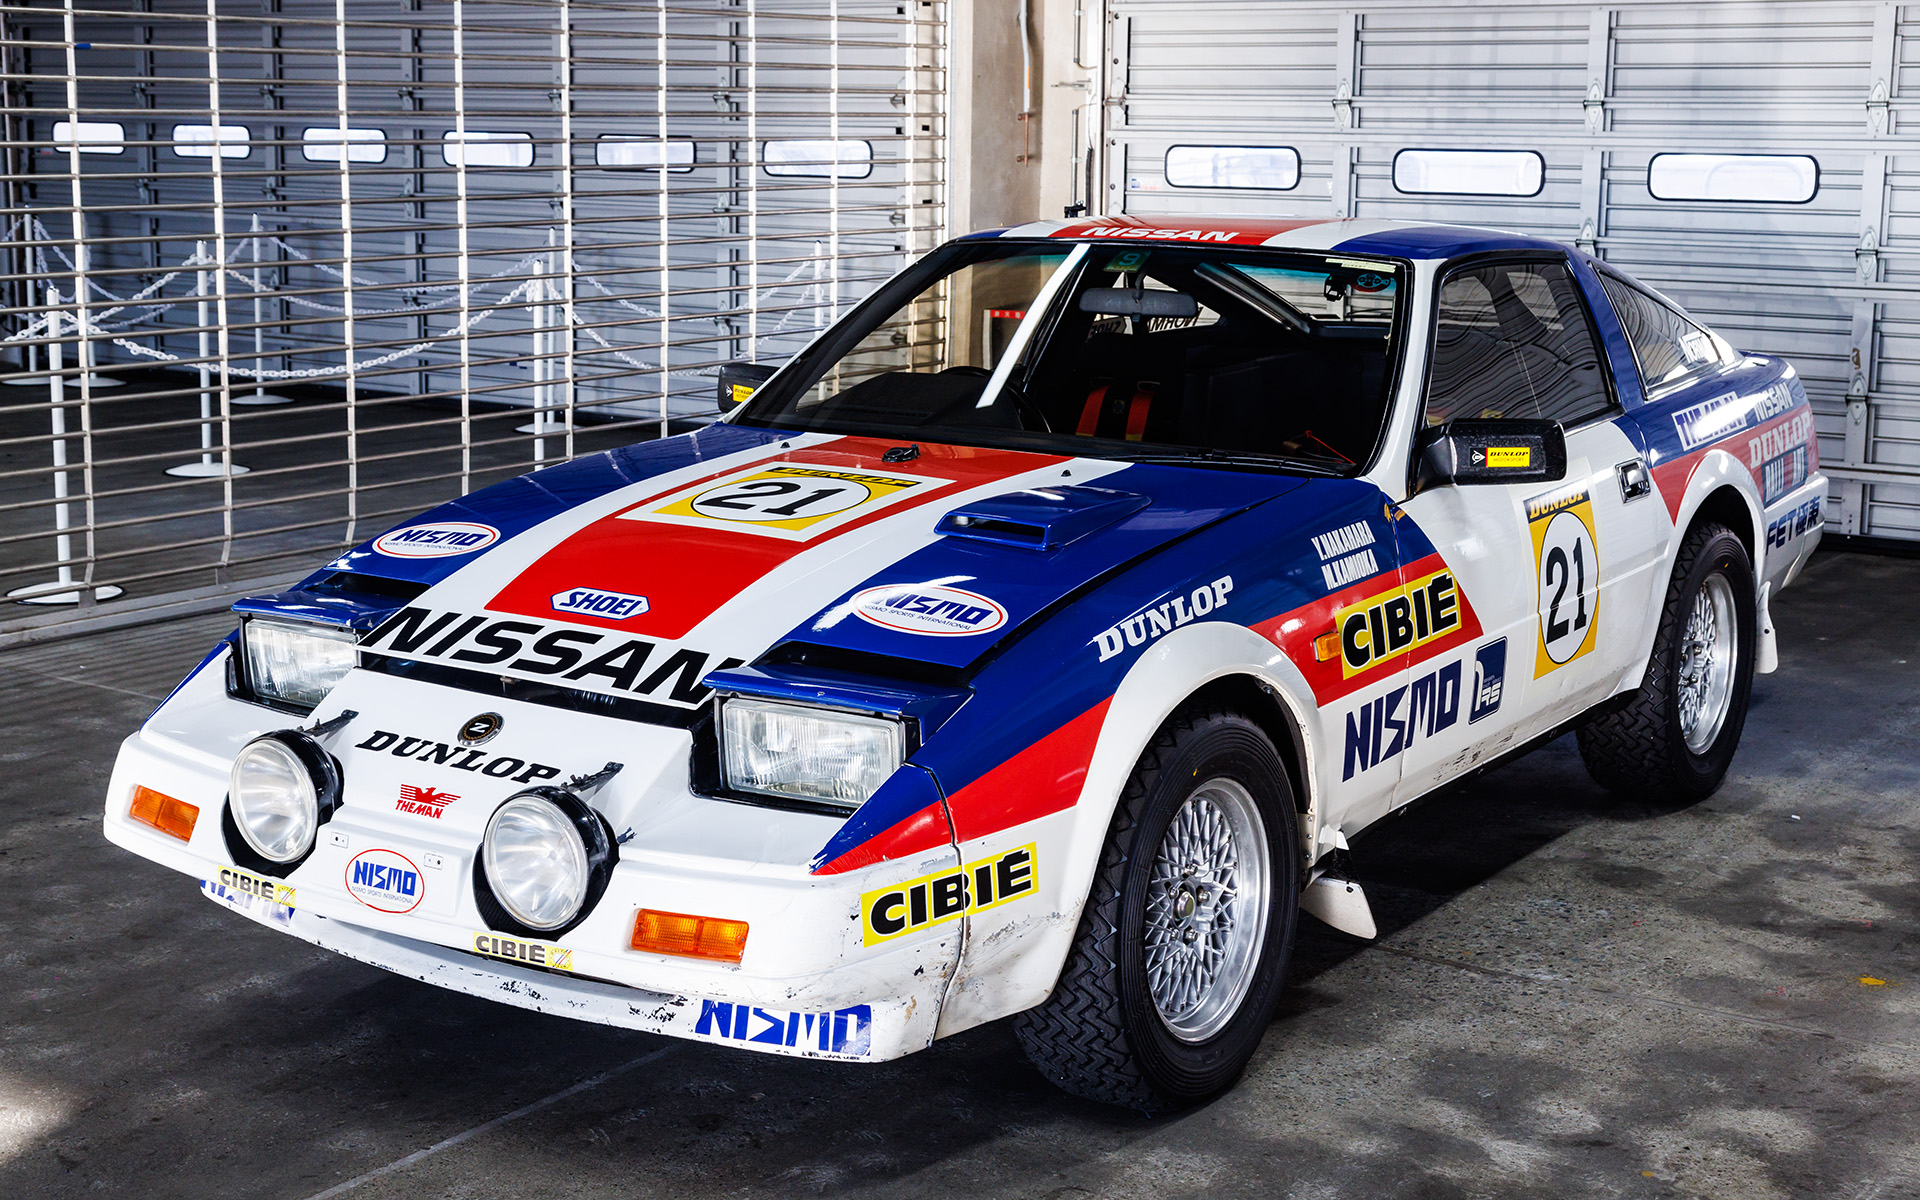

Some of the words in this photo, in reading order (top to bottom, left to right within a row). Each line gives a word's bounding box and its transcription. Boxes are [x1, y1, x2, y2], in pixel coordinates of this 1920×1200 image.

[1080, 227, 1239, 242] NISSAN
[1118, 253, 1141, 266] 9
[1753, 382, 1794, 422] NISSAN
[1749, 411, 1812, 469] DUNLOP
[776, 468, 918, 487] DUNLOP
[696, 481, 847, 516] 21
[1529, 490, 1584, 519] DUNLOP
[390, 529, 490, 547] NISMO
[1310, 520, 1377, 561] Y.NAKAHARA
[1321, 548, 1380, 590] M.KAMIOKA
[559, 590, 641, 617] SHOEI
[873, 592, 994, 625] NISMO
[1546, 537, 1587, 645] 21
[888, 609, 915, 618] SPORTS
[917, 615, 972, 630] INTERNATIONAL
[1093, 575, 1234, 662] DUNLOP
[1342, 571, 1458, 669] CIBIÉ
[360, 606, 747, 705] NISSAN
[469, 722, 490, 733] Z
[1342, 659, 1462, 783] NISMO
[355, 729, 562, 785] DUNLOP
[220, 868, 274, 900] CIBIÉ
[353, 859, 417, 897] NISMO
[869, 848, 1032, 935] CIBIÉ
[475, 935, 545, 964] CIBIÉ
[695, 999, 872, 1056] NISMO
